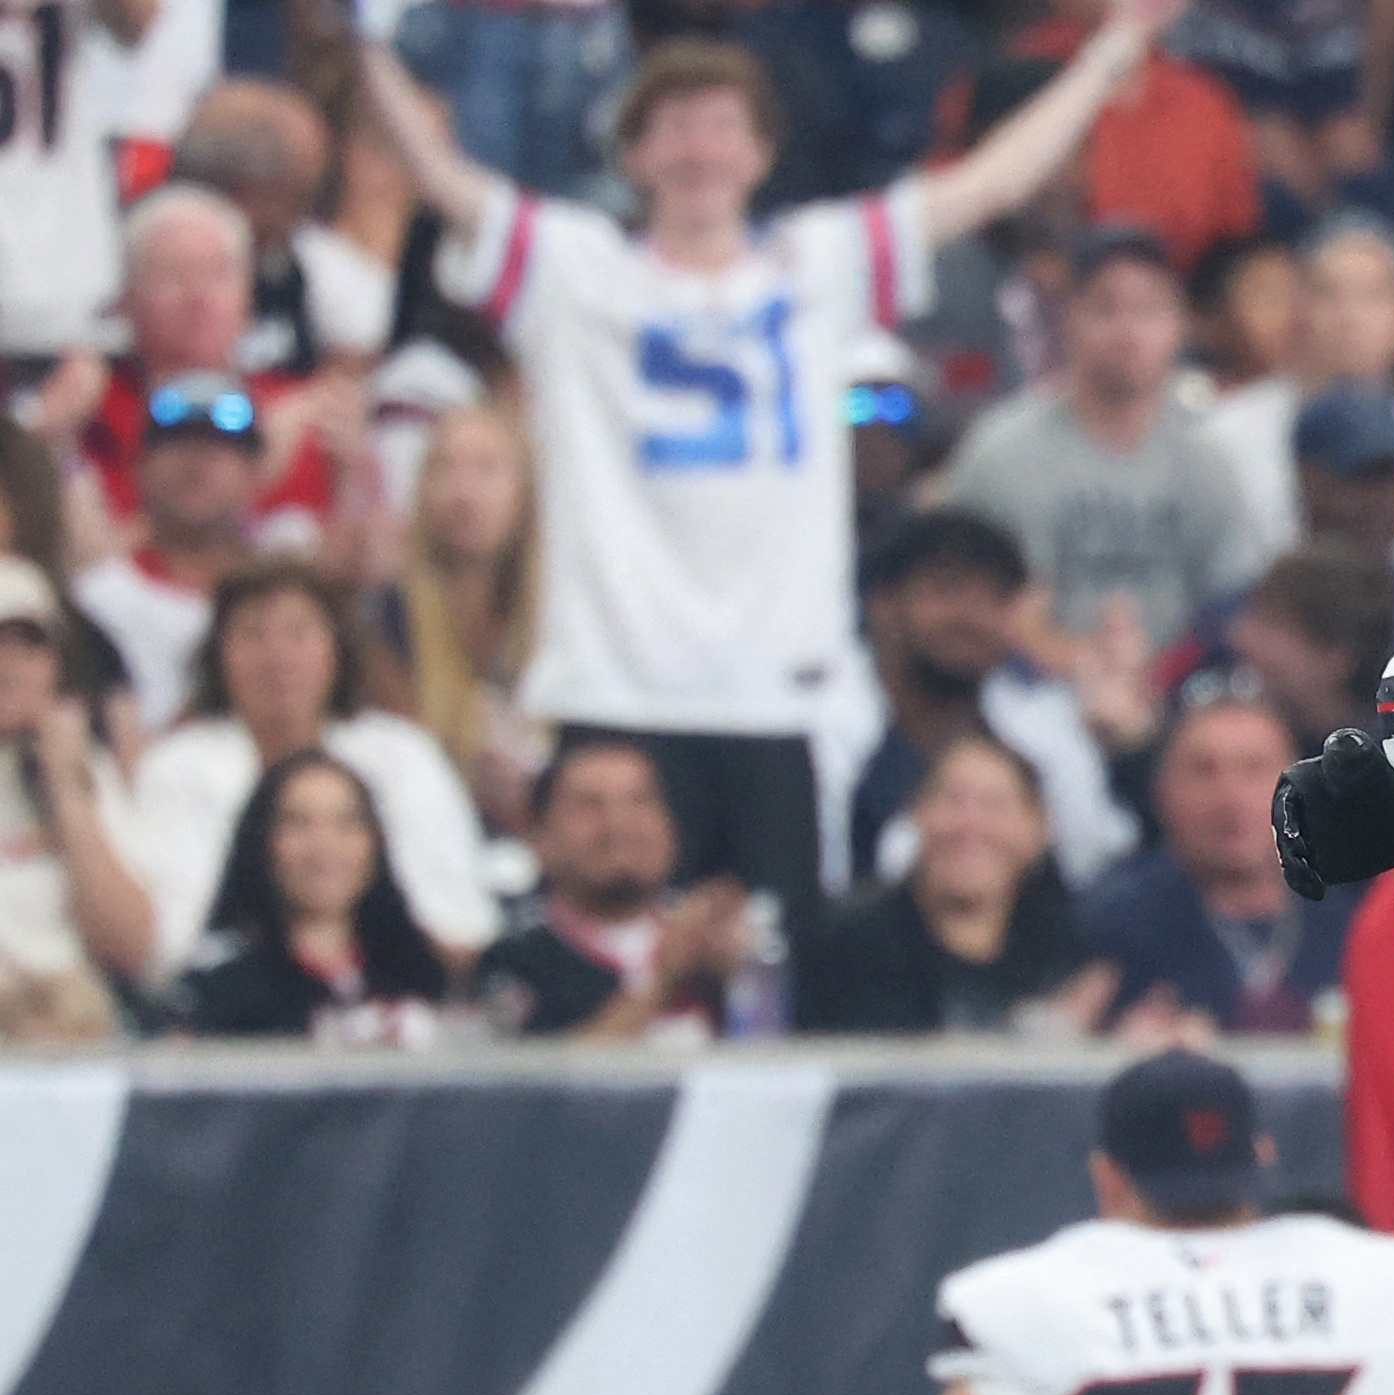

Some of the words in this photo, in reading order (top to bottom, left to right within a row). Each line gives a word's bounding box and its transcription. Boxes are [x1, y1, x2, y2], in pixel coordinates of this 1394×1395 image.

[0, 3, 62, 152] 1
[634, 293, 803, 470] 51
[1105, 1278, 1336, 1353] TELLER
